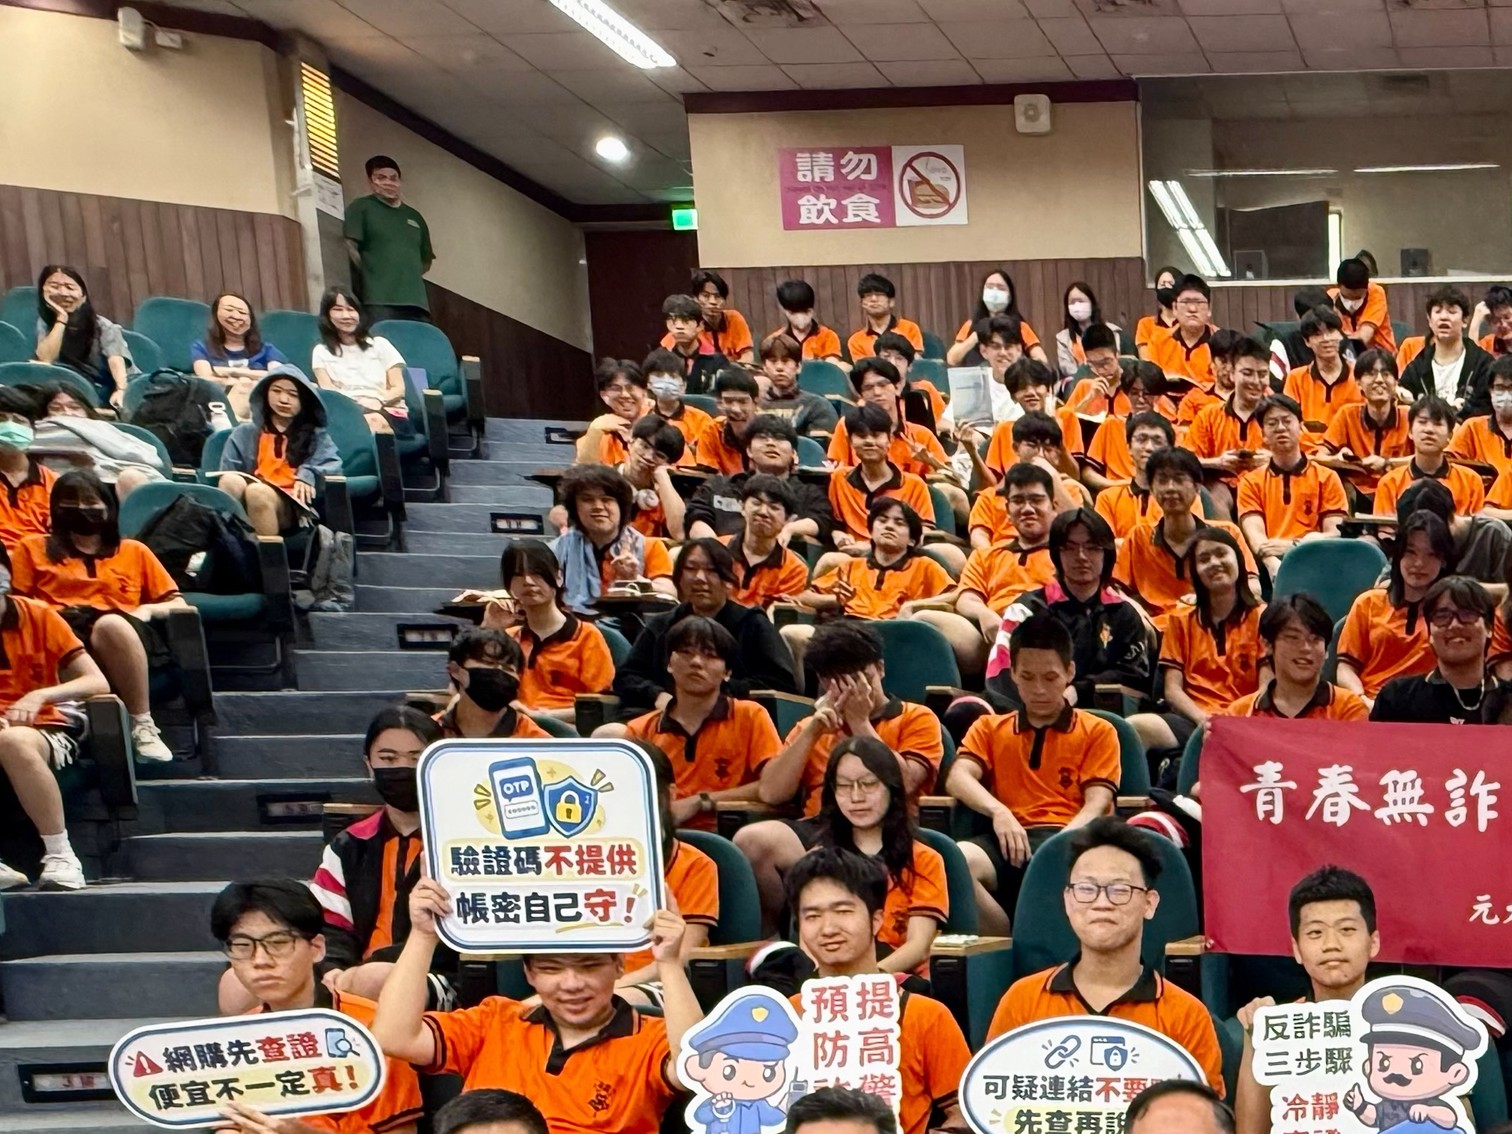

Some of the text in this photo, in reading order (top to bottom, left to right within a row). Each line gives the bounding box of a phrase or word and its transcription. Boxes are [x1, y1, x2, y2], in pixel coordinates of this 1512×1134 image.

[796, 151, 878, 183] 請勿
[797, 193, 881, 225] 飲食
[502, 780, 531, 795] OTP
[1239, 760, 1502, 834] 青春無詐
[450, 843, 638, 876] 驗證碼不提供
[810, 983, 851, 1090] 預防
[1263, 1009, 1352, 1042] 反詐騙
[162, 1031, 323, 1074] 網購先查證
[1264, 1047, 1353, 1076] 三步驟
[982, 1074, 1166, 1103] 可疑連結不要
[1281, 1092, 1340, 1122] 冷靜
